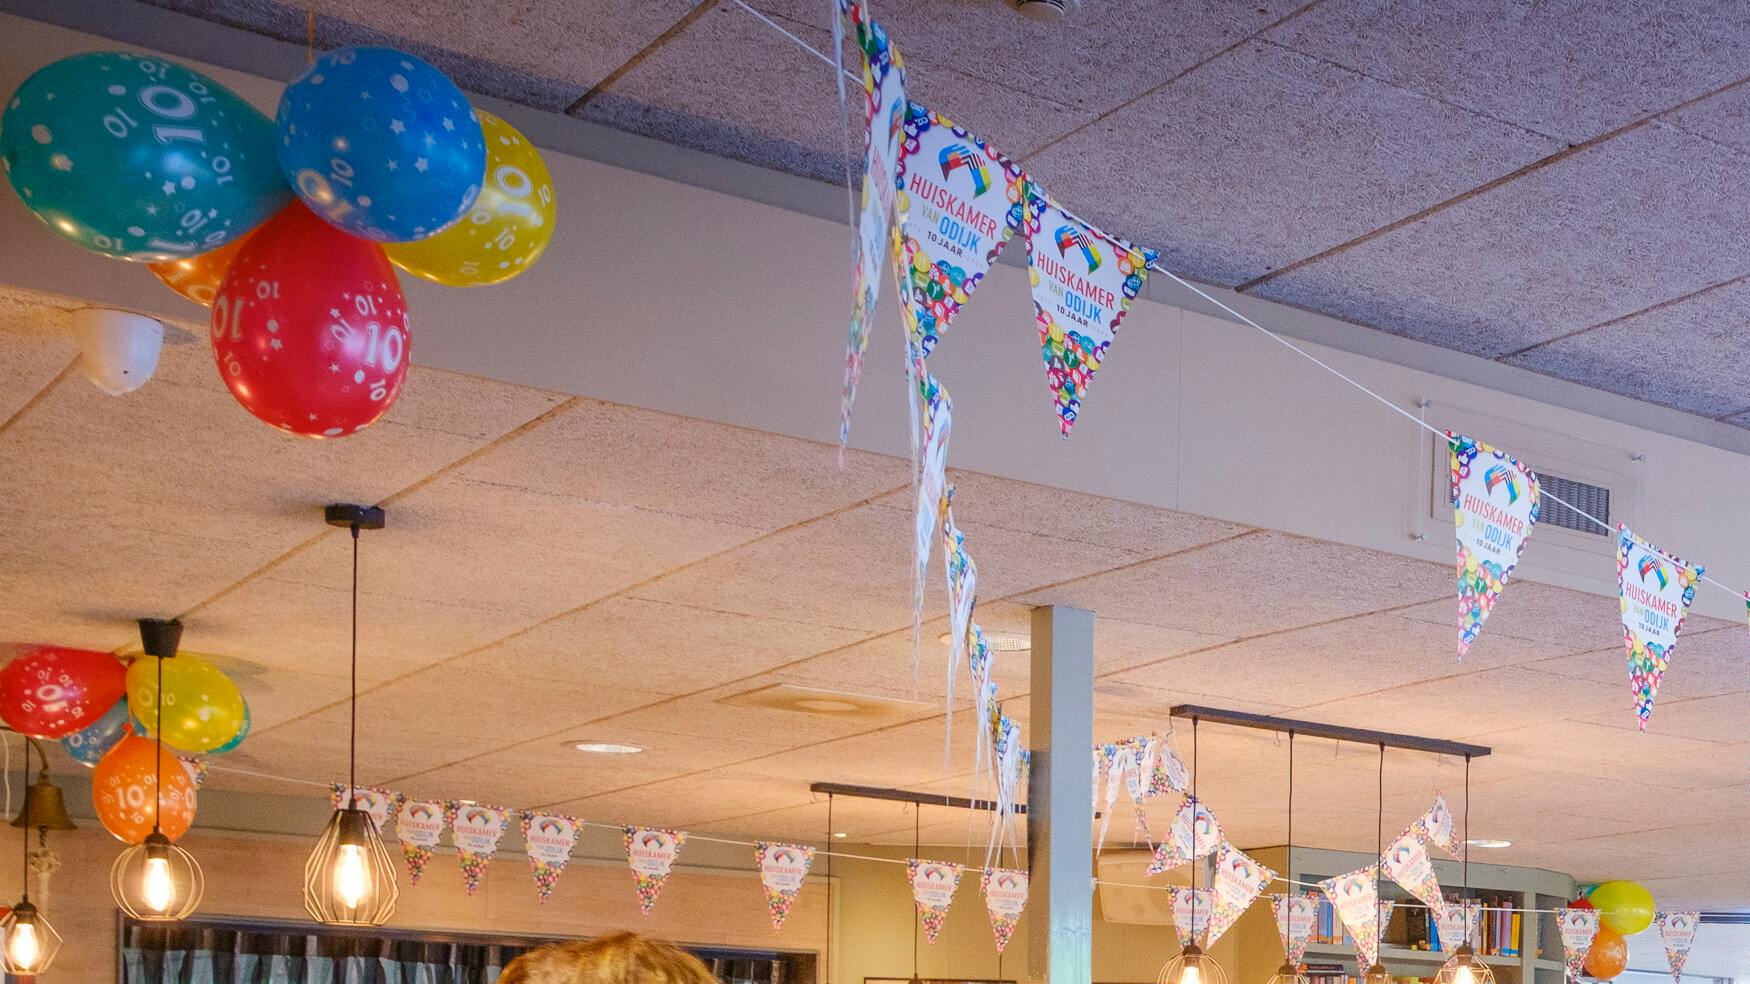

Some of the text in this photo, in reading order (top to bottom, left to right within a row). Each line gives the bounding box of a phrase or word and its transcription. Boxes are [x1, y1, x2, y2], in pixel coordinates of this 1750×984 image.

[138, 85, 207, 144] 10
[212, 156, 234, 185] 10
[331, 158, 354, 187] 10
[909, 173, 997, 240] HUISKAMER
[921, 207, 981, 254] VAN ODIJK
[927, 230, 963, 257] 10 JAAR
[1037, 250, 1115, 310] HUISKAMER
[355, 295, 377, 316] 10
[1049, 283, 1101, 324] VAN ODIJK
[1056, 304, 1088, 328] 10 JAAR
[366, 321, 403, 374] 10
[370, 378, 386, 401] 10
[1463, 493, 1523, 536] HUISKAMER
[1484, 525, 1513, 551] ODIJK
[1484, 542, 1500, 554] JAAR
[1626, 582, 1677, 618] HUISKAMER
[1645, 609, 1668, 632] ODIJK
[116, 784, 145, 810] 10
